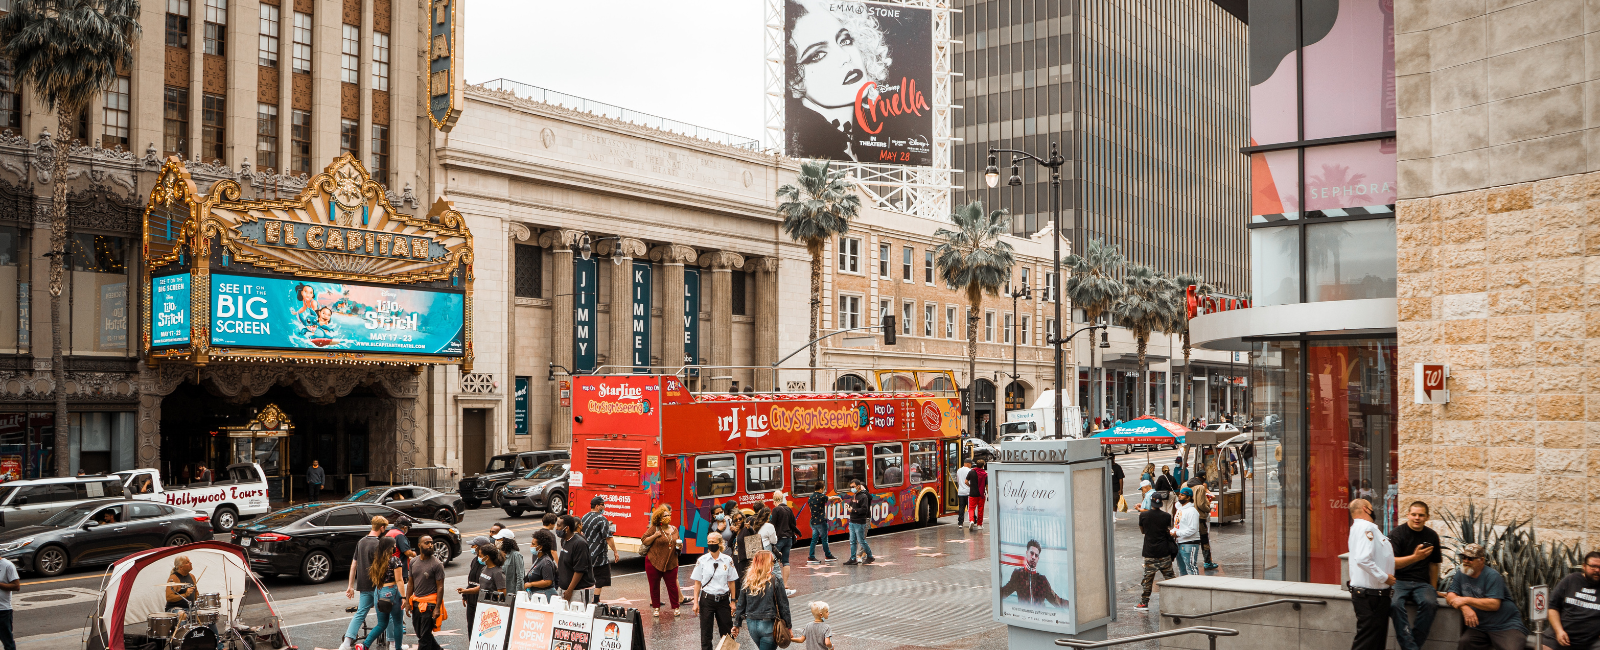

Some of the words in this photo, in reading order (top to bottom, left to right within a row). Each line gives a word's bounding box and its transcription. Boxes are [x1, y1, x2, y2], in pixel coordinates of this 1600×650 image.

[830, 4, 864, 14] EMMA
[868, 7, 900, 18] STONE
[854, 76, 930, 134] Cruella
[880, 150, 897, 162] MAY
[900, 152, 910, 161] 28
[1310, 181, 1390, 200] SEPHORA
[264, 220, 299, 246] EL
[306, 226, 430, 259] CAPITAN
[219, 283, 239, 294] SEE
[244, 285, 253, 294] IT
[217, 294, 268, 320] BIG
[577, 271, 589, 356] JIMMY
[684, 284, 692, 343] LIVE
[633, 270, 644, 364] KIMMEL
[216, 320, 270, 334] SCREEN
[667, 380, 675, 391] 24
[588, 399, 643, 415] CitySightseeing
[874, 404, 885, 414] Hop
[886, 404, 894, 414] On
[770, 404, 860, 433] CitySightseeing
[874, 417, 885, 428] Hop
[886, 416, 895, 427] Off
[996, 449, 1067, 461] DIRECTORY
[166, 488, 226, 508] Hollywood
[230, 486, 264, 500] Tours
[1003, 480, 1030, 505] Only
[1032, 490, 1056, 499] one
[523, 620, 544, 631] NOW
[519, 630, 544, 642] OPEN!
[555, 629, 570, 640] NOW
[571, 632, 589, 643] OPEN
[476, 641, 497, 650] NOW
[600, 640, 621, 649] CABO
